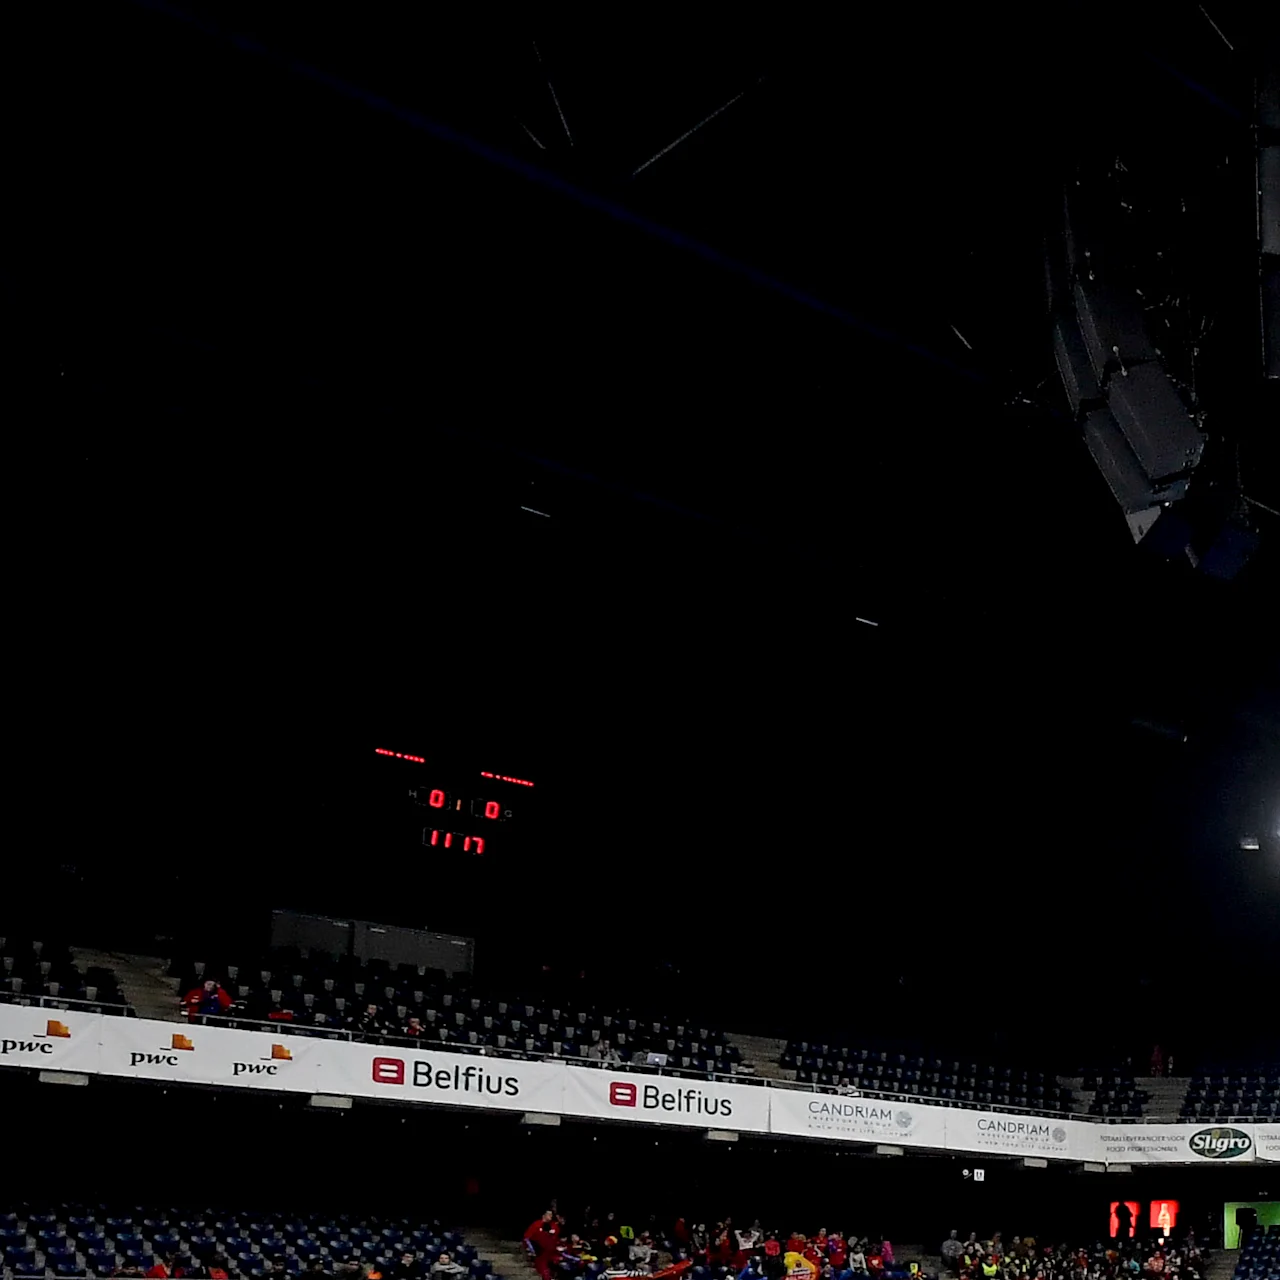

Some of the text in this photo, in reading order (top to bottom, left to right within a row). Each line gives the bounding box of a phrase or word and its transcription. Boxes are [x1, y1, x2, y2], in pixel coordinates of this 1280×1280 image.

[429, 789, 445, 808] 0
[485, 801, 500, 819] 0
[1, 1039, 53, 1054] pwc
[130, 1051, 179, 1066] pwc
[232, 1062, 278, 1076] pwc
[412, 1060, 520, 1096] Belfius
[643, 1085, 733, 1117] Belfius
[808, 1101, 892, 1120] CANDRIAM
[977, 1119, 1050, 1136] CANDRIAM
[1191, 1134, 1250, 1152] Sligro
